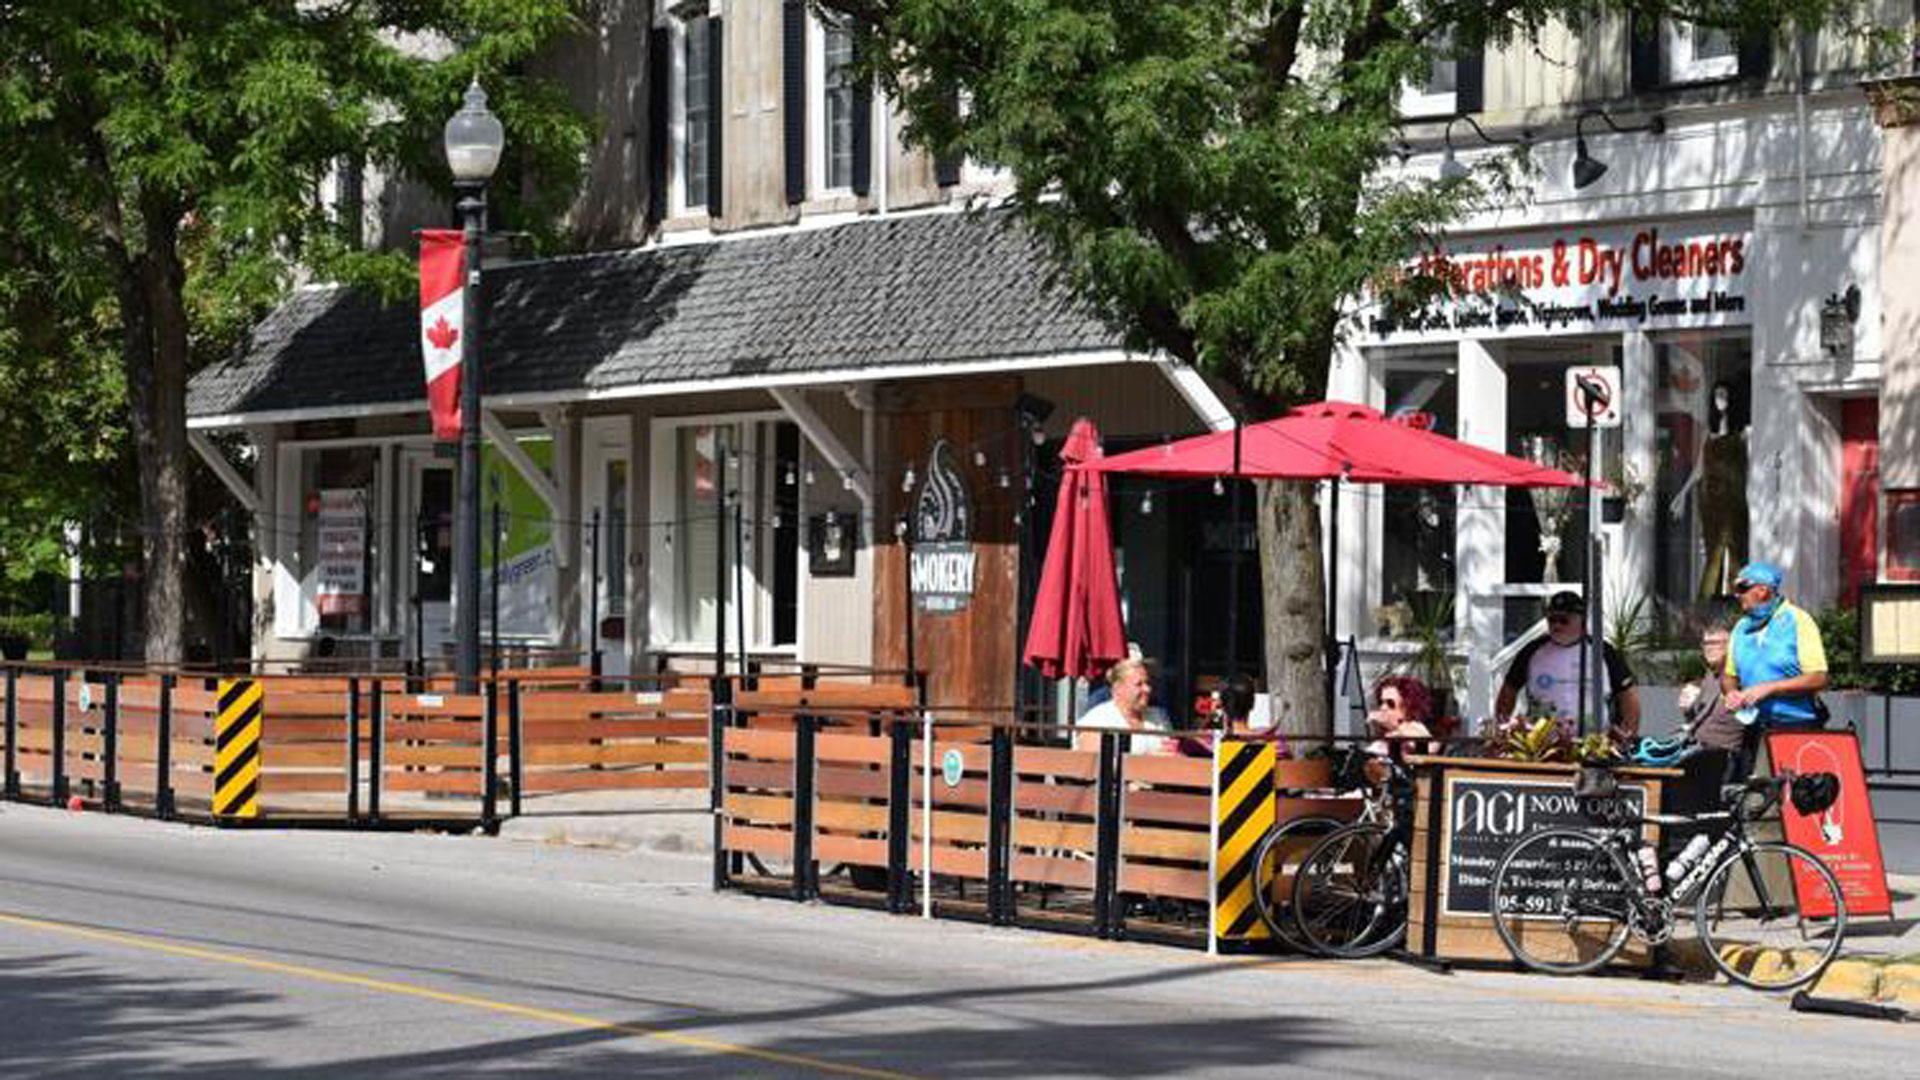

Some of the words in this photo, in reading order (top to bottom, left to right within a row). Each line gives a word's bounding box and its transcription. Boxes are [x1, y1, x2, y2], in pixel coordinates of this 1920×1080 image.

[1551, 239, 1569, 287] &
[1578, 237, 1624, 296] Dry
[1632, 227, 1745, 281] Cleaners
[1691, 291, 1712, 313] and
[1714, 291, 1745, 312] More
[1456, 790, 1525, 835] AGI
[1530, 796, 1580, 814] NOW
